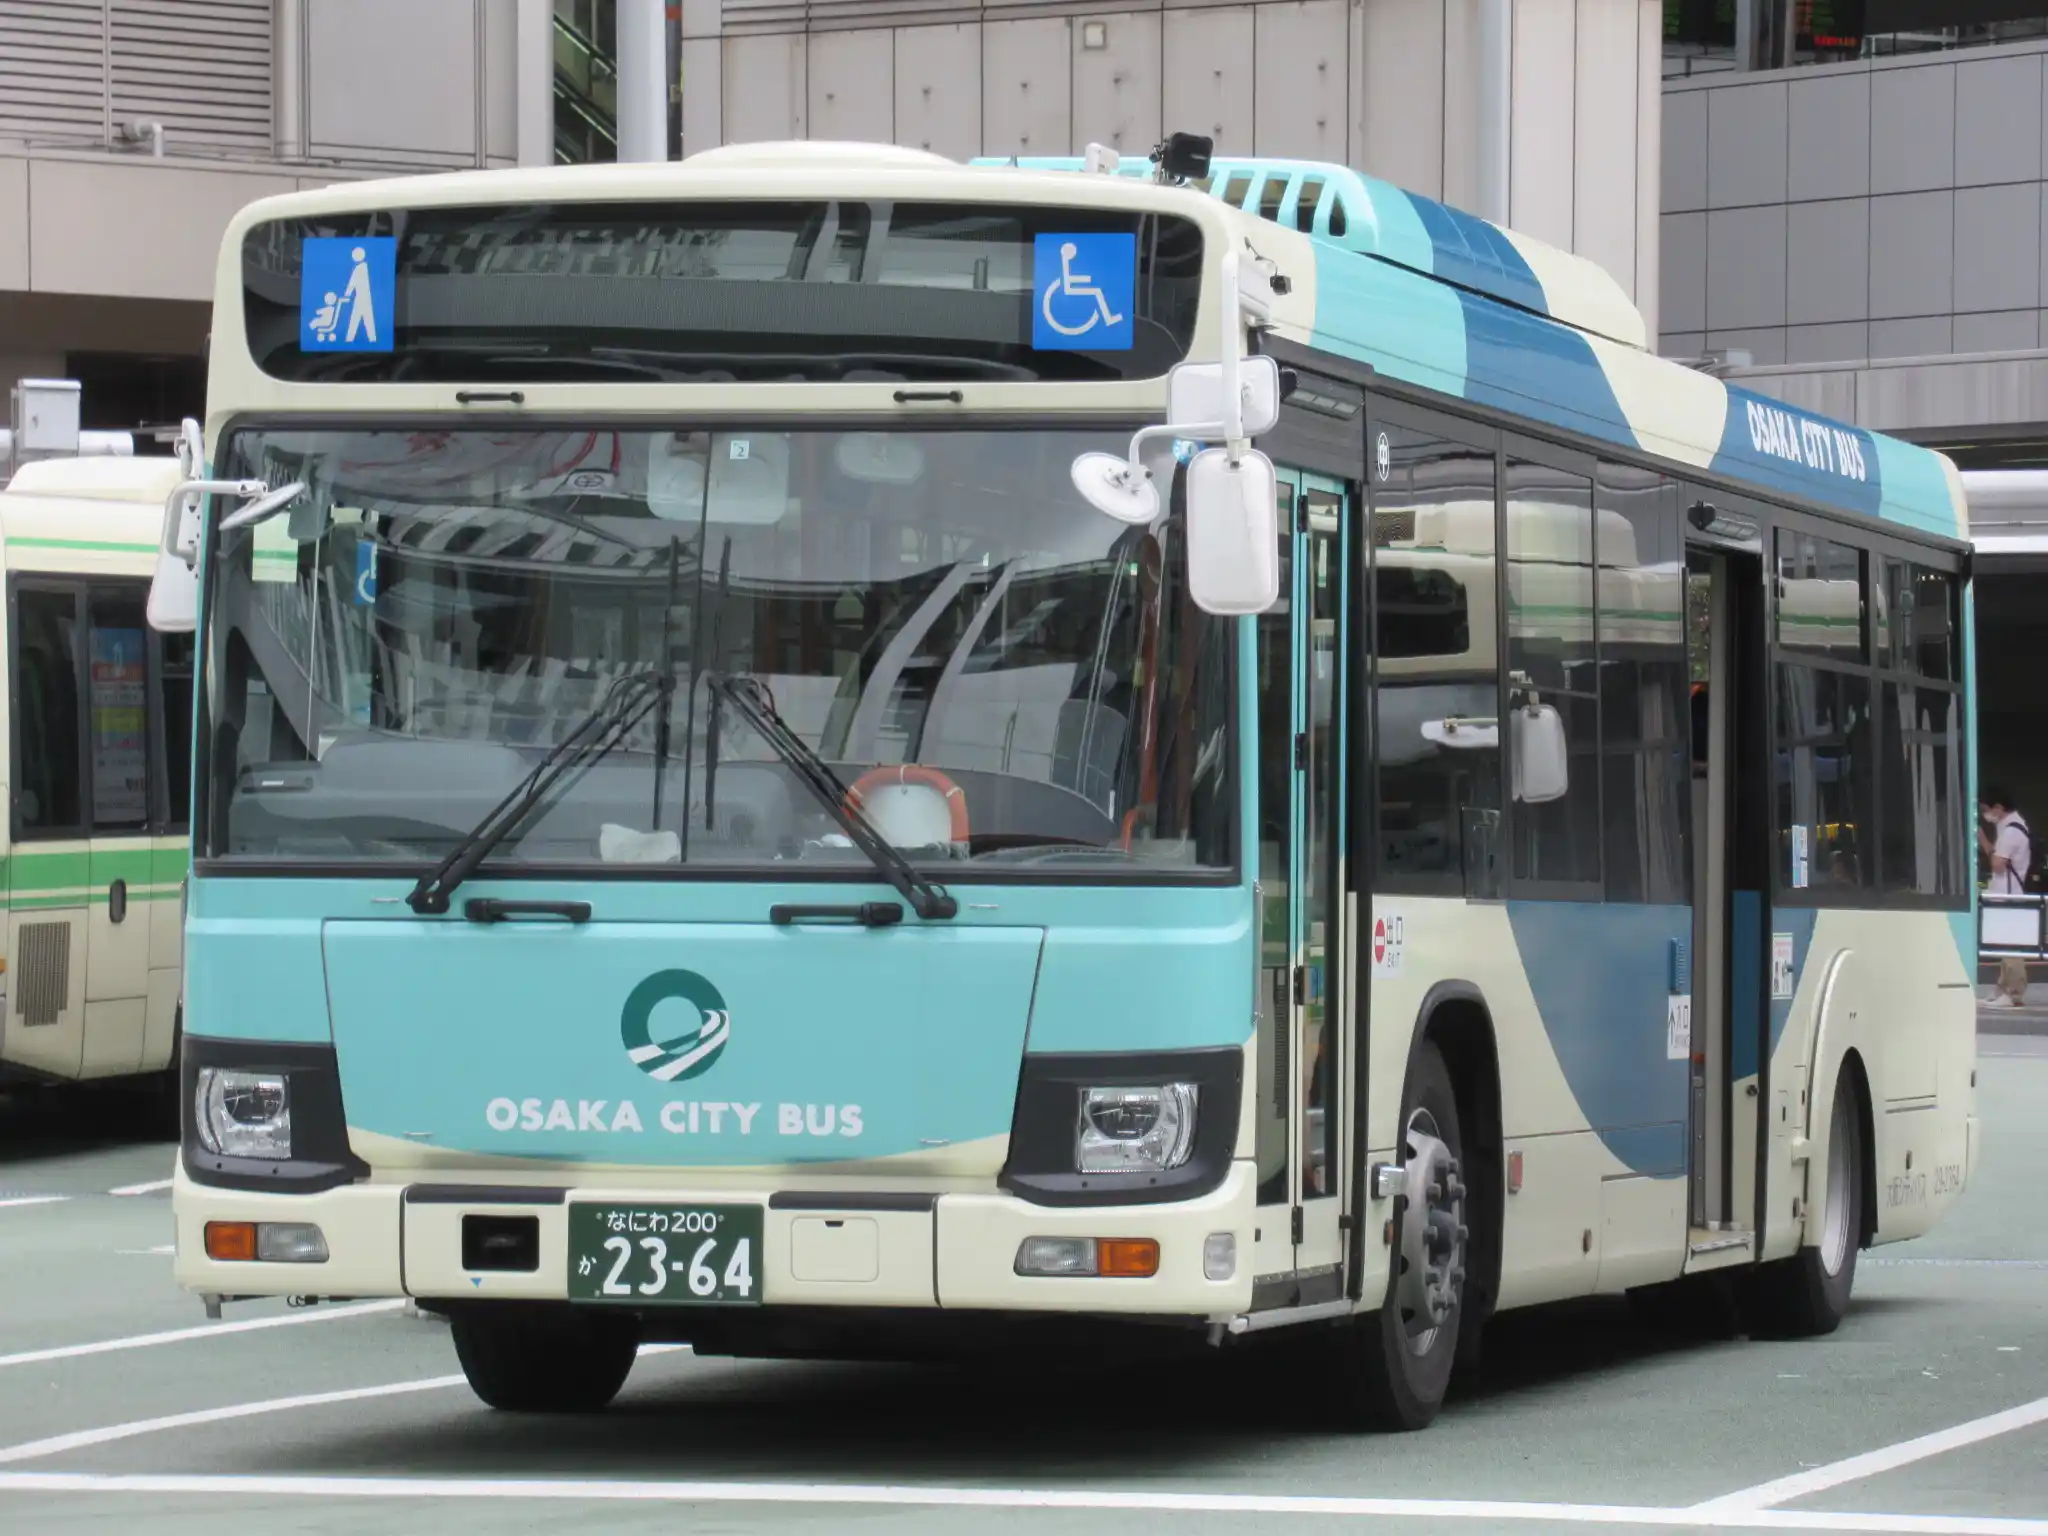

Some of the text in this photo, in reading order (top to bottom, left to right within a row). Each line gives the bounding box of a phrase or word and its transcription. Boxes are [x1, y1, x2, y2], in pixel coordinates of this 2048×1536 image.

[1746, 399, 1866, 481] OSAKA CITY BUS
[486, 1097, 864, 1136] OSAKA CITY BUS
[578, 1236, 753, 1297] か 23-64
